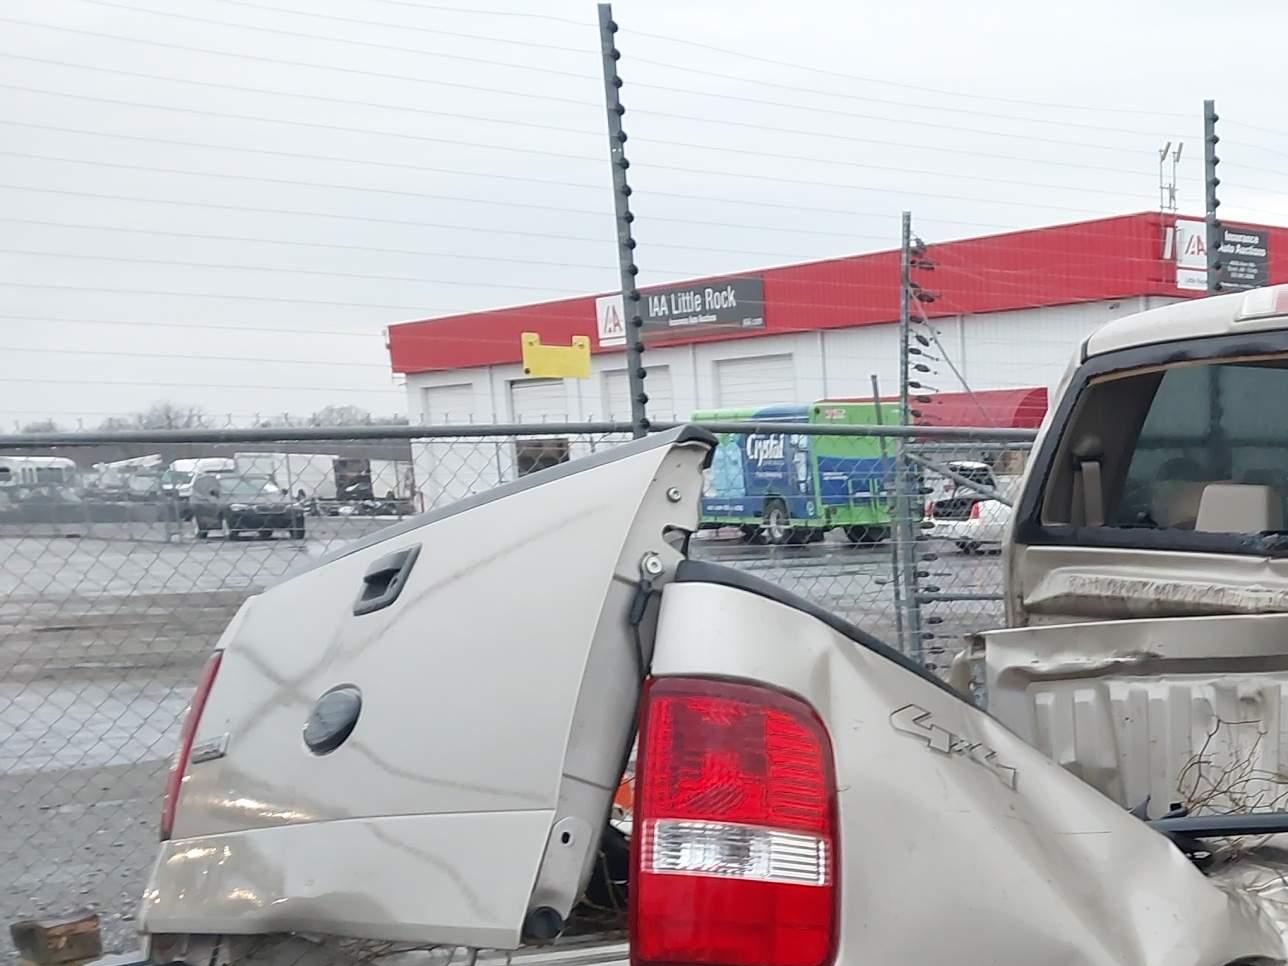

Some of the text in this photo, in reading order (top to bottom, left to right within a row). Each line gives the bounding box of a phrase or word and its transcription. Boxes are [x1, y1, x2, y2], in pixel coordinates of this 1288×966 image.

[649, 286, 736, 317] IAA Little Rock
